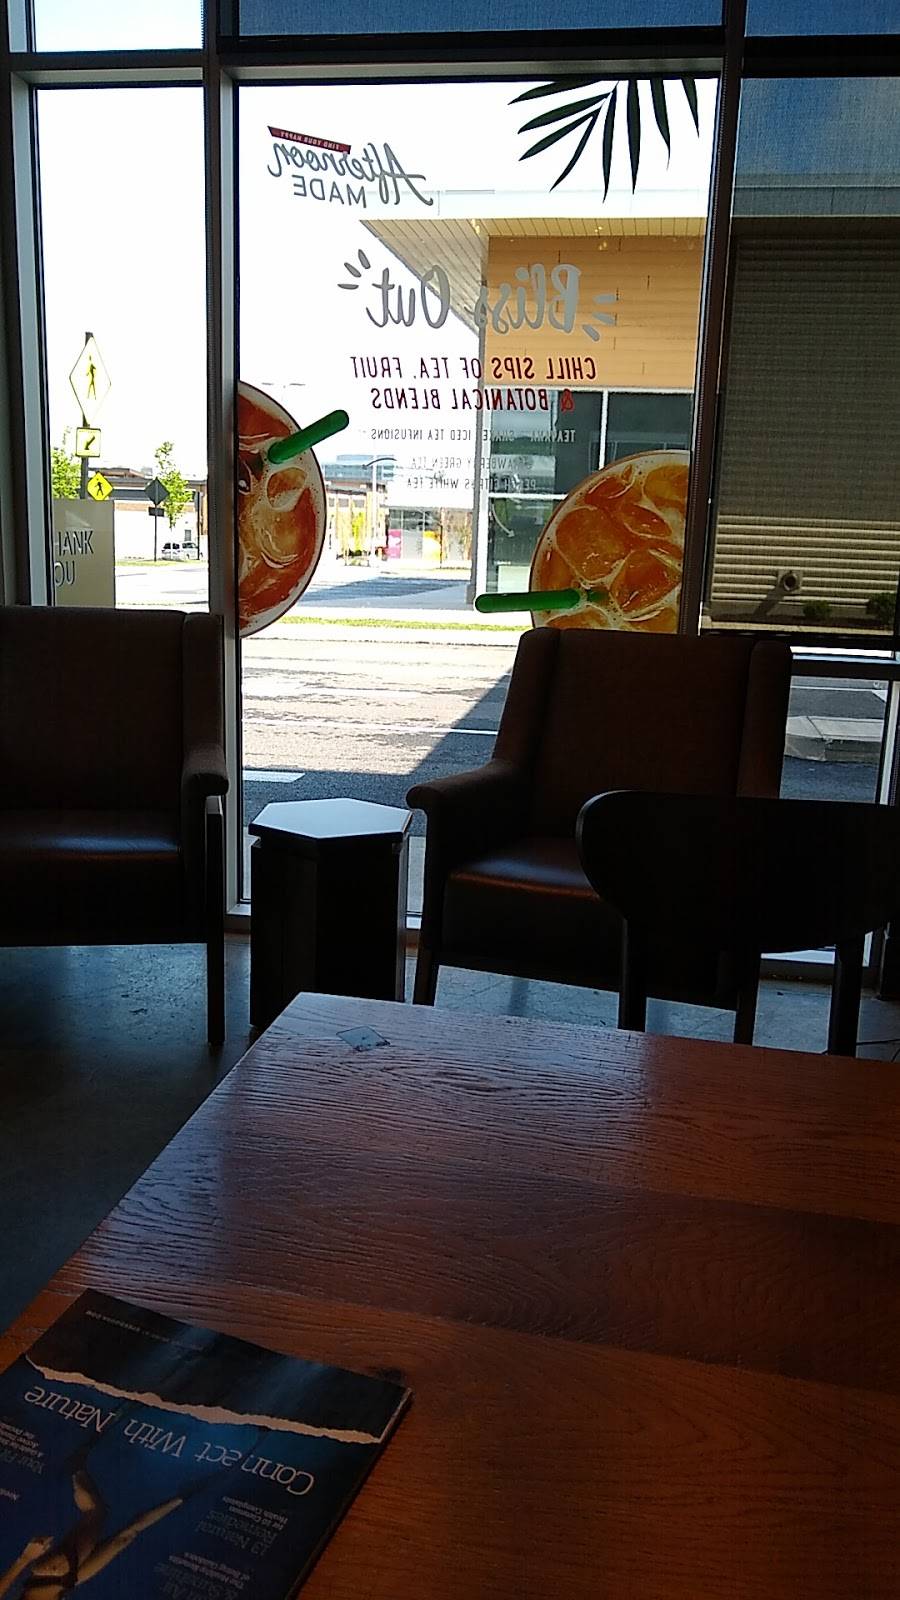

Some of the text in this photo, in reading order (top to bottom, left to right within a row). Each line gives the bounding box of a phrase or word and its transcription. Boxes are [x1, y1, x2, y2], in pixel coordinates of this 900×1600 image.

[54, 530, 94, 556] HANK
[54, 560, 76, 587] OU
[24, 1385, 116, 1433] Nature
[123, 1418, 187, 1459] With
